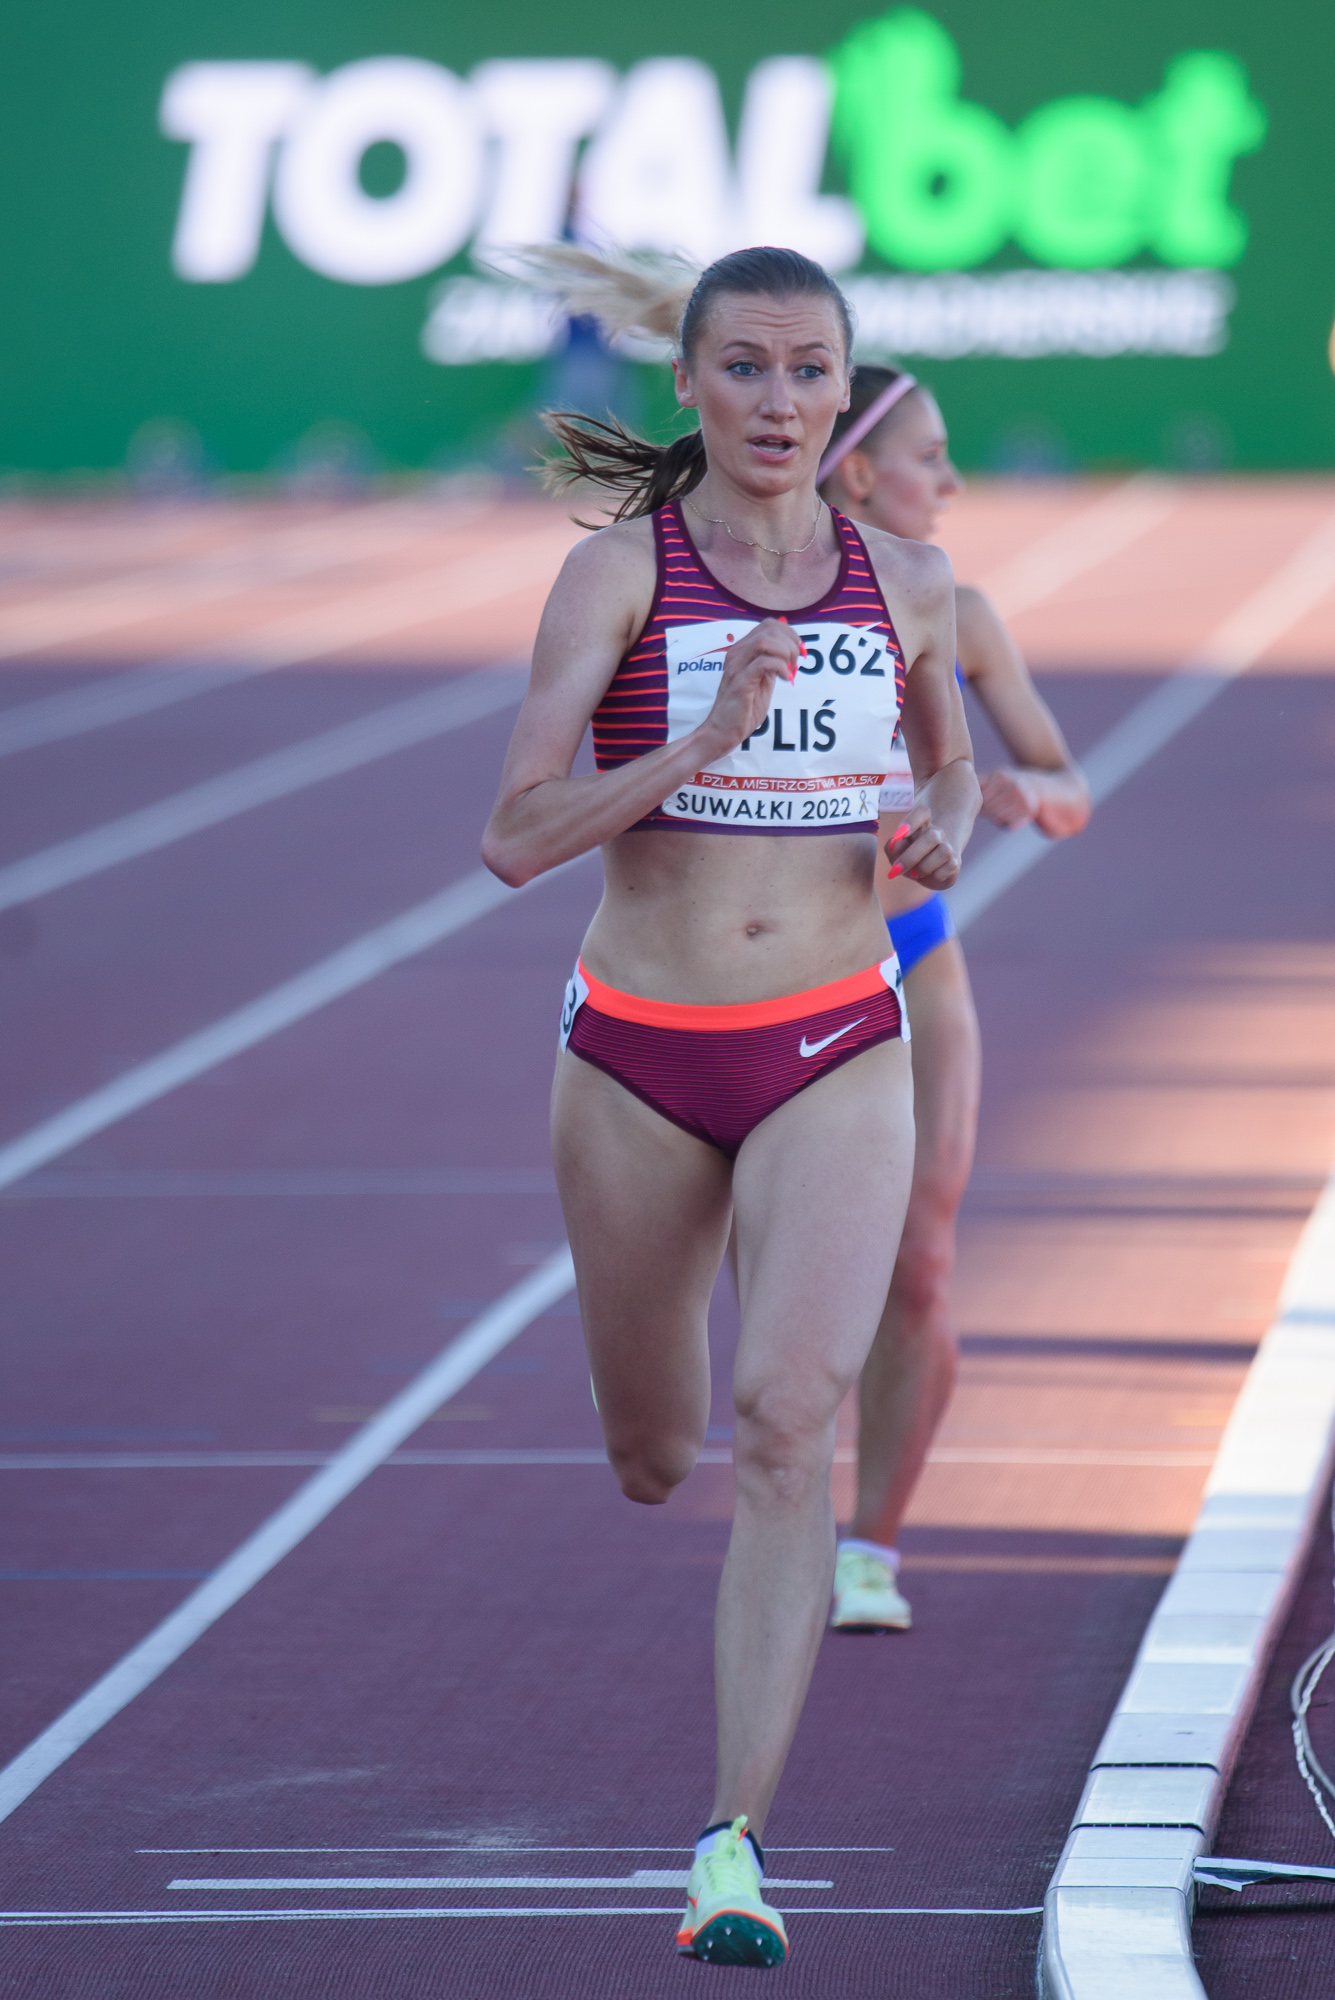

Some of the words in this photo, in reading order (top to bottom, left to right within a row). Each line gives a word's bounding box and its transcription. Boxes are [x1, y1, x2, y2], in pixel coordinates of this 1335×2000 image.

[677, 658, 725, 675] polan
[701, 774, 739, 789] PZLA
[742, 776, 836, 791] MISTRZOSTWA
[837, 775, 880, 787] POLSKI
[675, 791, 793, 820] SUWAŁKI
[801, 797, 852, 820] 2022
